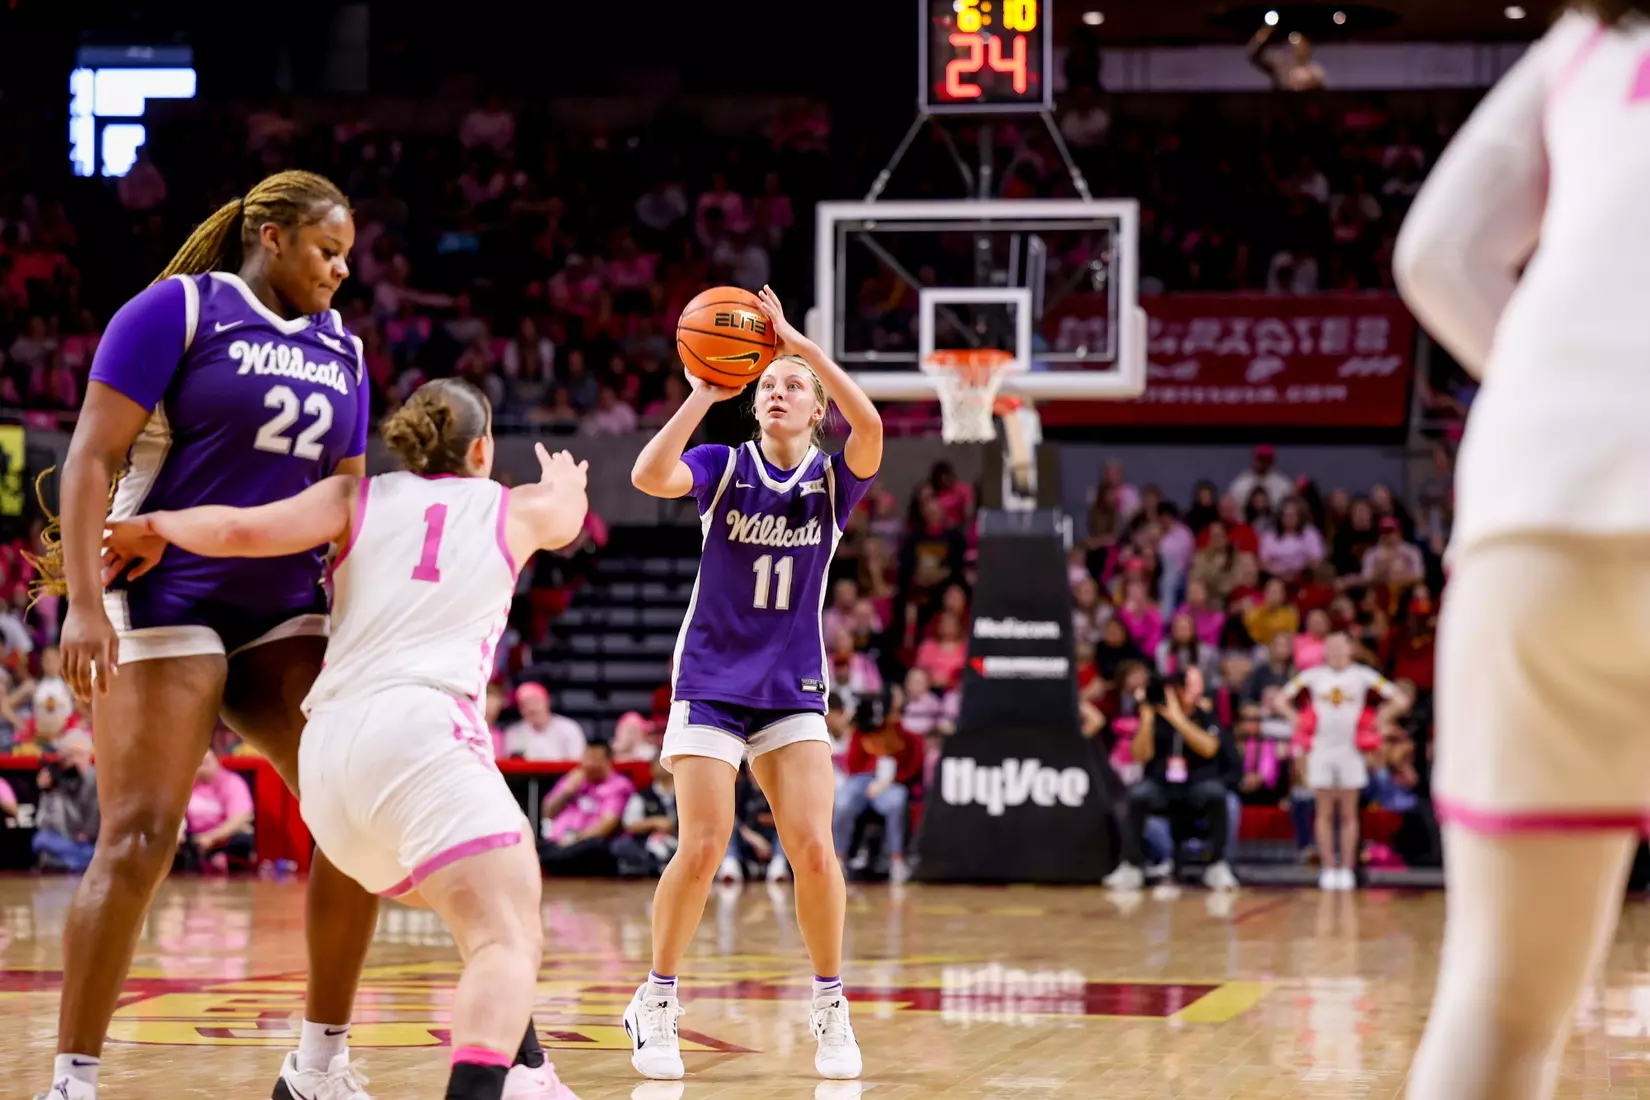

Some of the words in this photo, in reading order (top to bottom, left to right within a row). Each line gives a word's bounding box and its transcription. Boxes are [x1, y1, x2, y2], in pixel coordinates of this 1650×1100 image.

[946, 33, 1027, 98] 24
[714, 312, 768, 336] ELITE
[228, 340, 349, 395] Wildcats
[253, 385, 334, 461] 22
[411, 502, 448, 583] 1
[726, 509, 822, 547] Wildcats
[752, 554, 794, 610] 11
